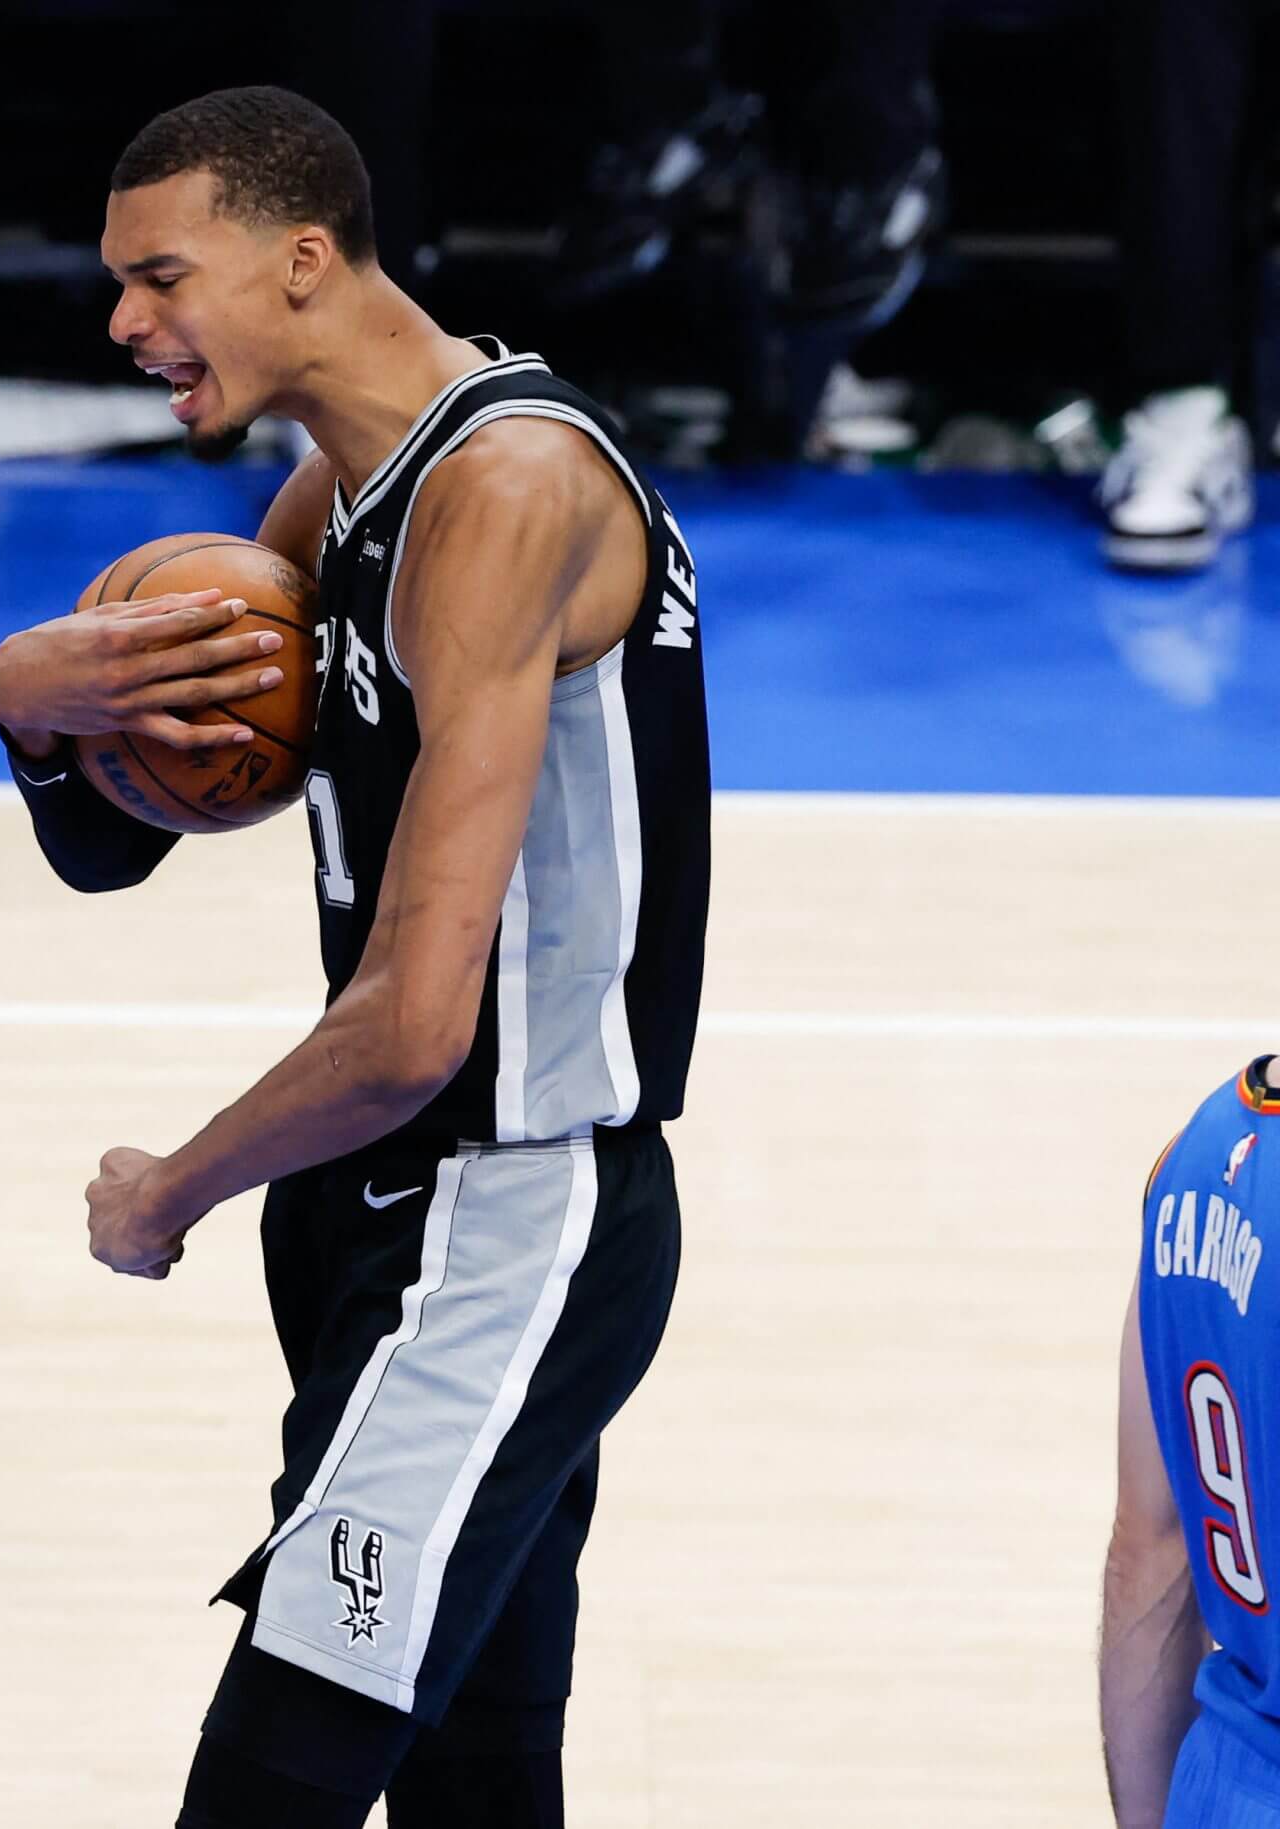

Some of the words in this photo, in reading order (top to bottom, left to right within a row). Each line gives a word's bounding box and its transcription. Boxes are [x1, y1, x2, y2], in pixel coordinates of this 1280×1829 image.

[304, 768, 355, 909] 1
[1154, 1190, 1262, 1317] CARUSO
[1184, 1361, 1269, 1614] 9
